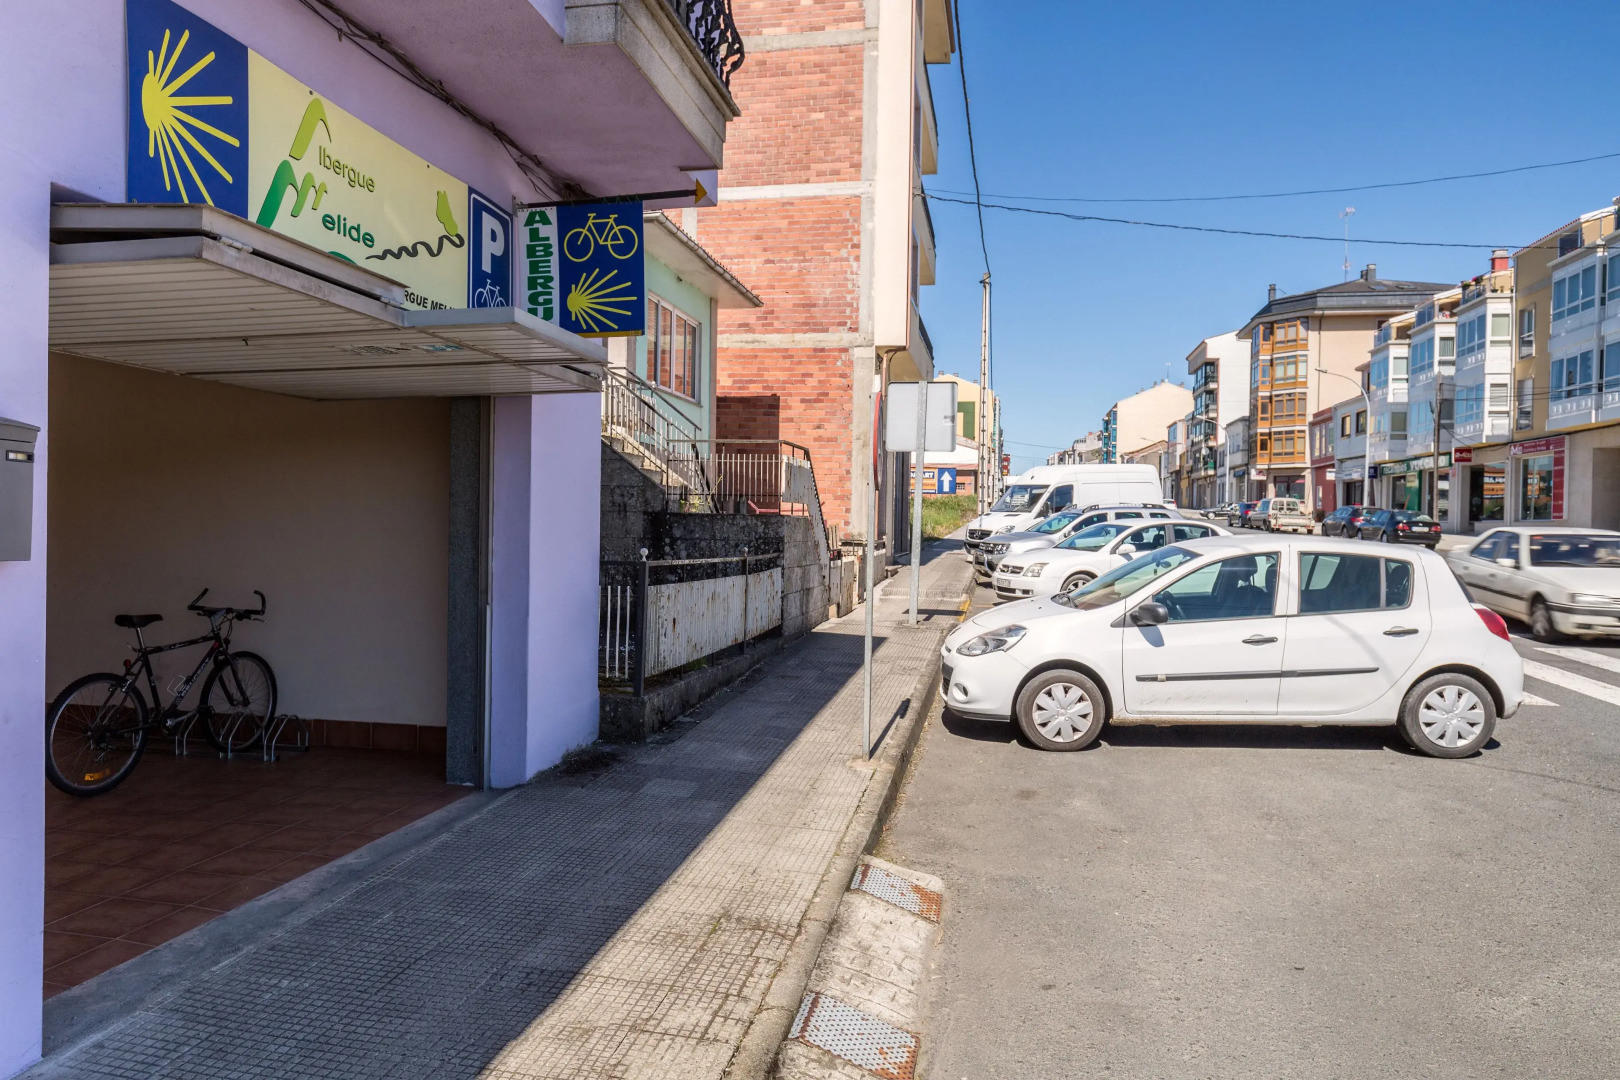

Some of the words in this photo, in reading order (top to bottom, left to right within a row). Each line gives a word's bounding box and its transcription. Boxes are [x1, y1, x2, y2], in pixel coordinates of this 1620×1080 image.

[481, 210, 505, 274] P
[523, 210, 555, 322] ALBERGU
[404, 289, 429, 309] RGUE
